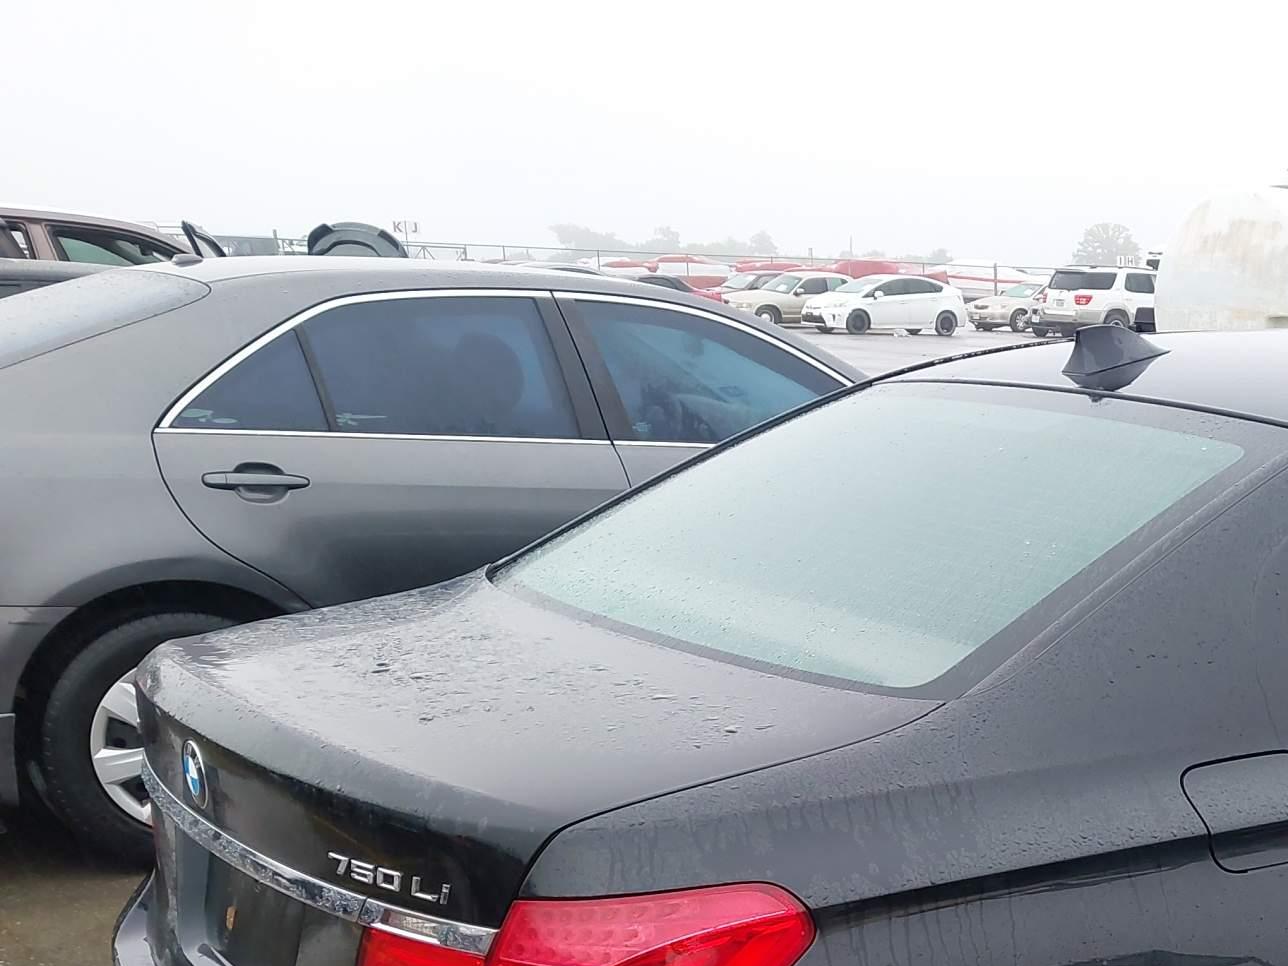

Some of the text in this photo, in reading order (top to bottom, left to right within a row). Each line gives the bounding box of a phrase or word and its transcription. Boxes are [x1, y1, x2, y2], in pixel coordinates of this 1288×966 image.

[392, 220, 403, 233] K
[327, 851, 450, 905] 750 Li
